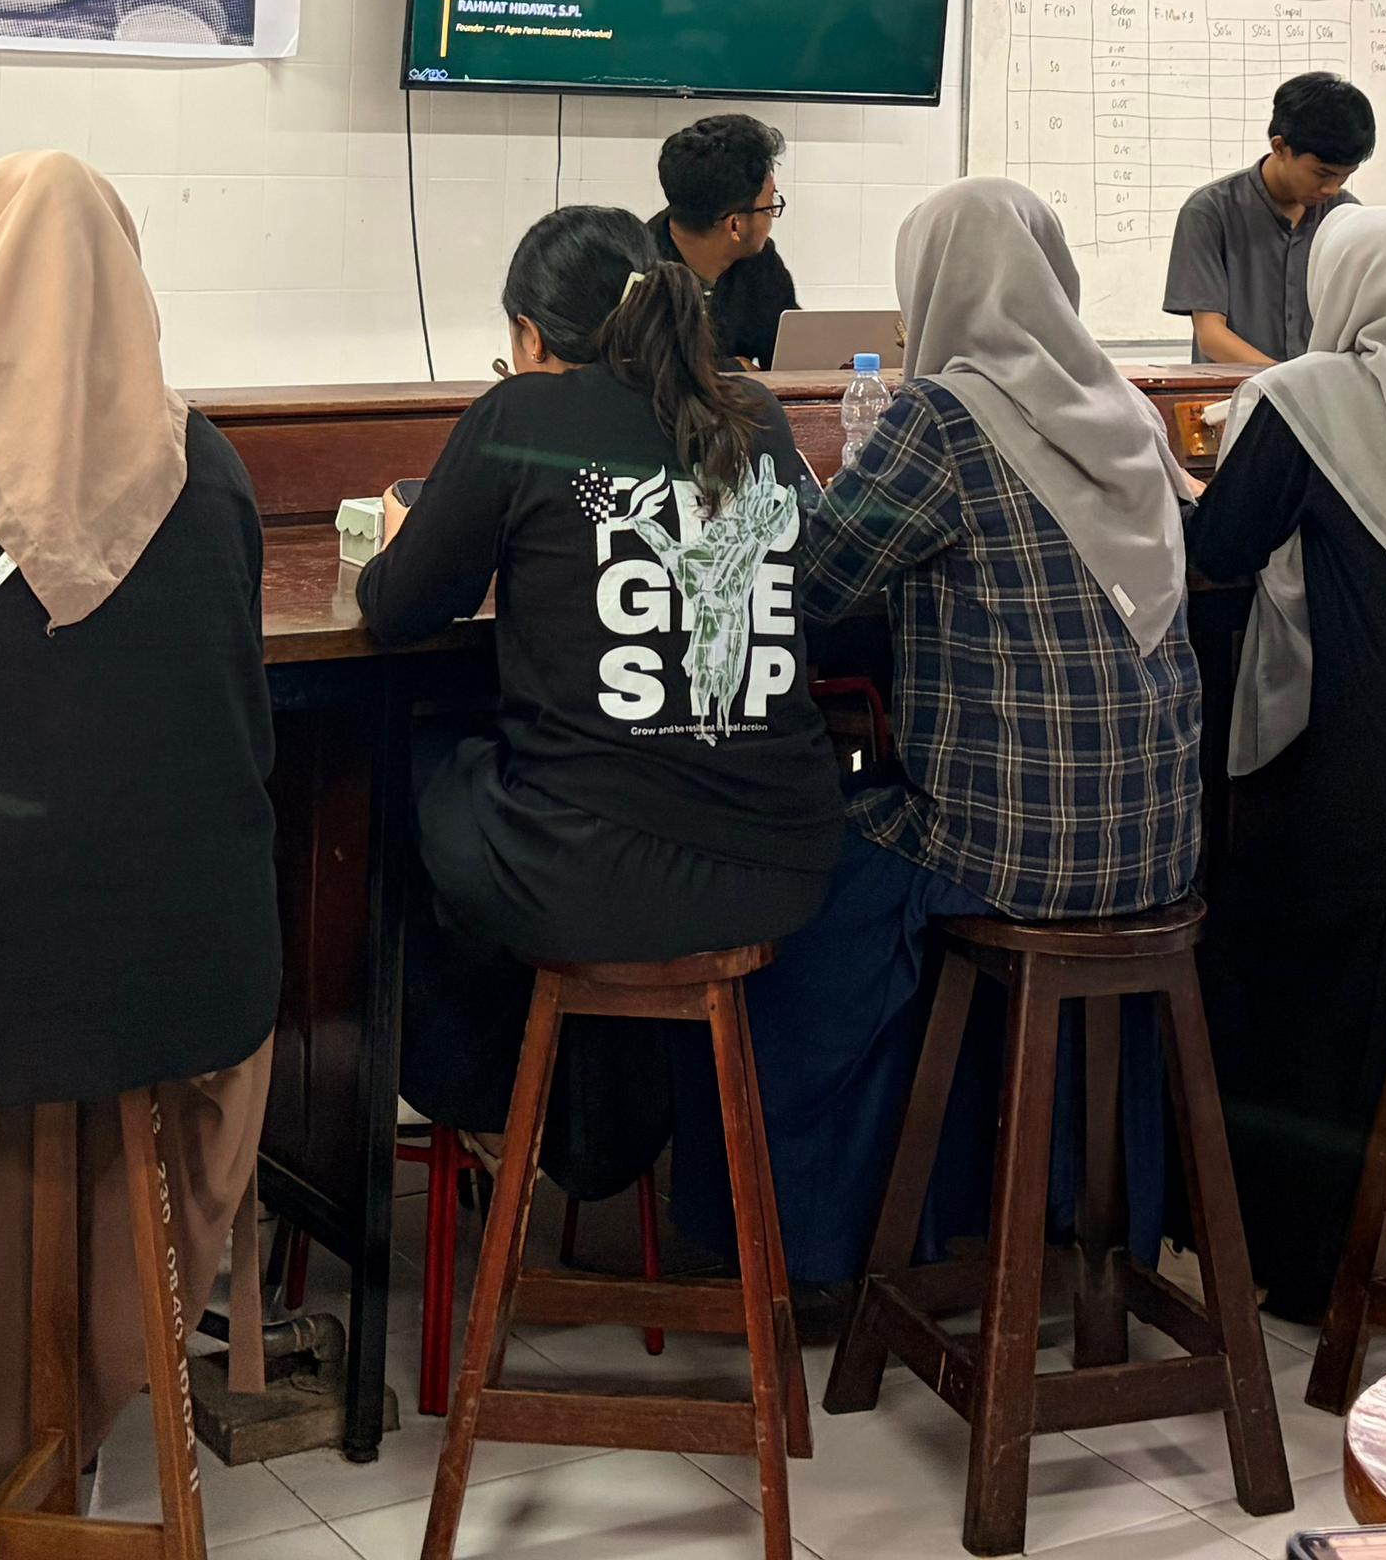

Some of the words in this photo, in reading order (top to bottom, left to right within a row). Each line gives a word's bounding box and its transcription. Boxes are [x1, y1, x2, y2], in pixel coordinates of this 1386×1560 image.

[457, 0, 507, 14] RAHMAT
[509, 1, 557, 18] HIDAYAT,
[456, 23, 485, 33] Founder
[494, 25, 505, 34] PT
[505, 25, 522, 36] Agro
[523, 26, 541, 36] Farm
[630, 726, 657, 736] Grow
[658, 724, 674, 735] and
[674, 724, 685, 734] be
[741, 722, 769, 732] action
[156, 1160, 172, 1225] 230
